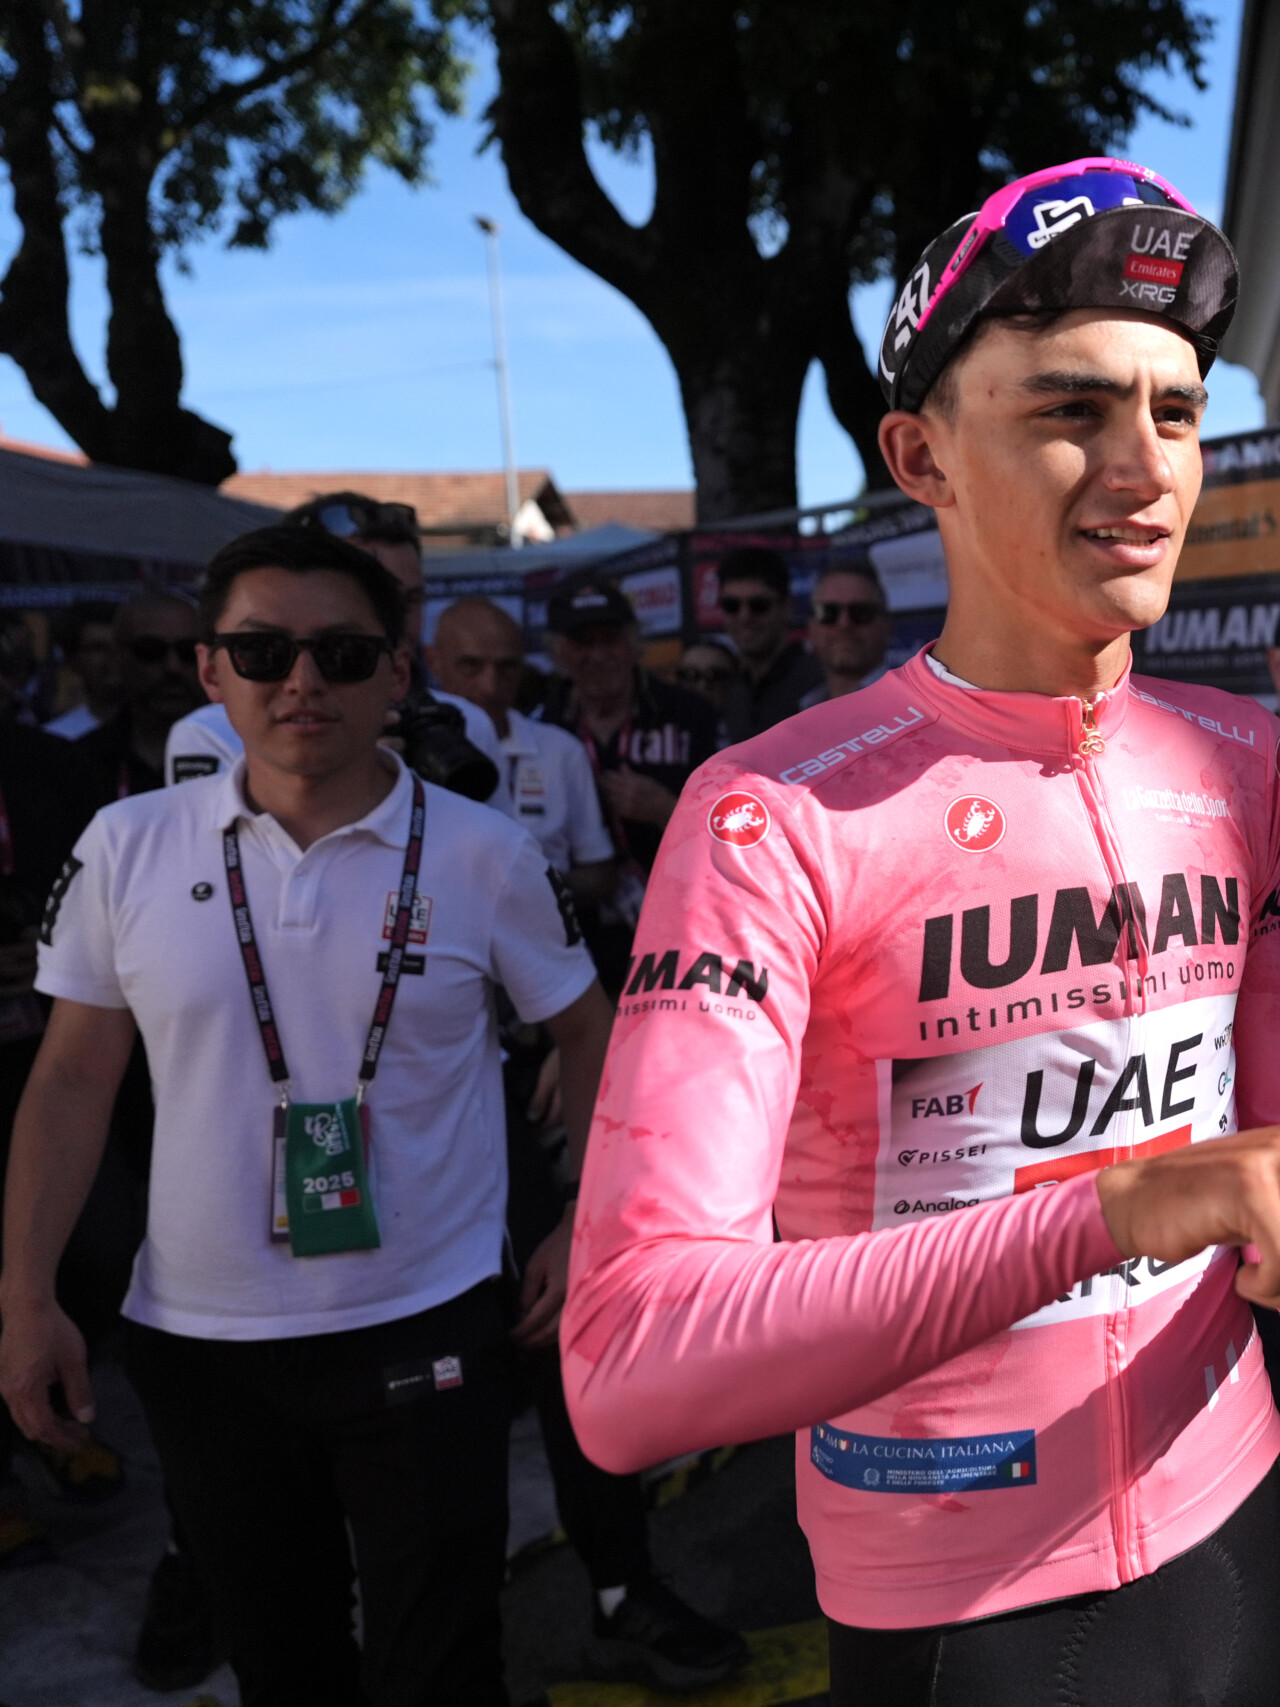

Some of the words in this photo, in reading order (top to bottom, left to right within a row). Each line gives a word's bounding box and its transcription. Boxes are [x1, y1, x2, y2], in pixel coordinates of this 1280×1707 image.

[1131, 224, 1195, 260] UAE
[1130, 260, 1178, 279] Emirates
[1119, 280, 1177, 303] XRG
[918, 873, 1240, 1004] IUMAN
[628, 949, 769, 1003] MAN
[699, 1000, 757, 1021] uomo
[920, 973, 1168, 1041] intimissimi
[1179, 959, 1236, 987] uomo
[1019, 1033, 1204, 1149] UAE
[911, 1094, 964, 1119] FAB
[919, 1144, 988, 1165] PISSEI
[302, 1170, 356, 1195] 2025
[912, 1198, 980, 1214] Analog
[853, 1442, 869, 1456] LA
[873, 1445, 935, 1459] CUCINA
[941, 1440, 1016, 1458] ITALIANA
